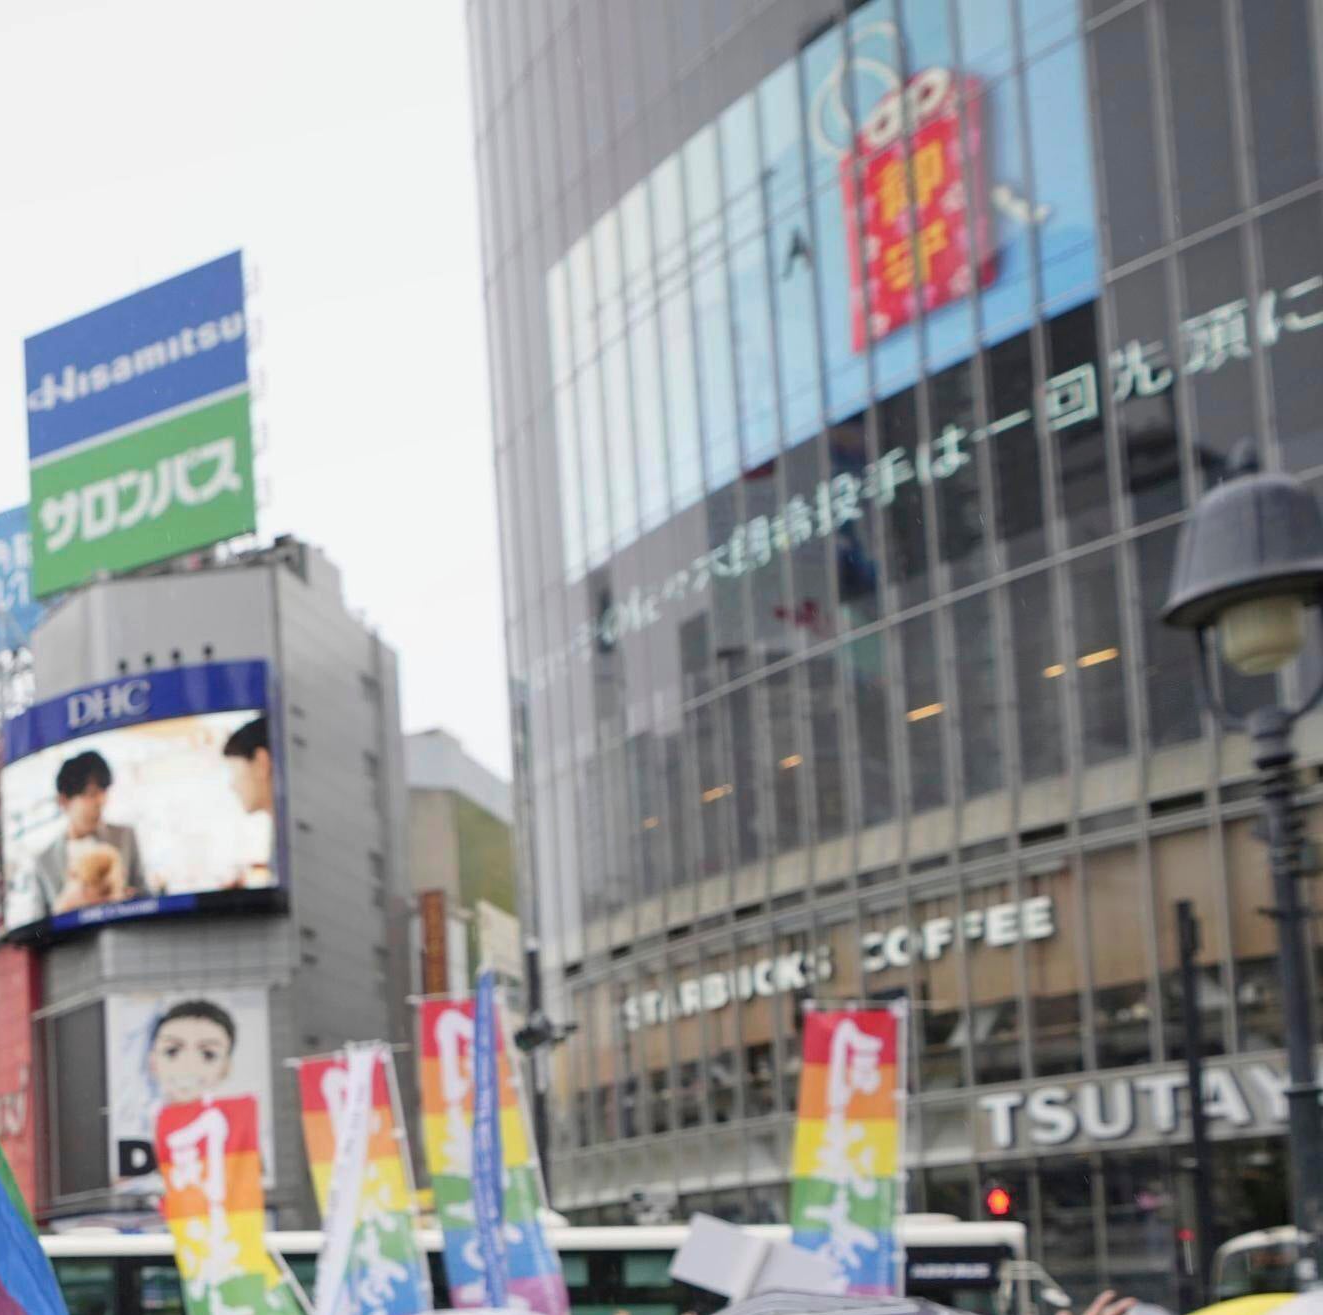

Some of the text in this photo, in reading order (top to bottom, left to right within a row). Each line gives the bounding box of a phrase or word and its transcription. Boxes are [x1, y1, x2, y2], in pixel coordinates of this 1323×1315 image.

[28, 310, 246, 411] Hisamitsu
[38, 436, 242, 554] サロンパス
[67, 679, 151, 730] DHC
[979, 1064, 1323, 1148] TSUTAY
